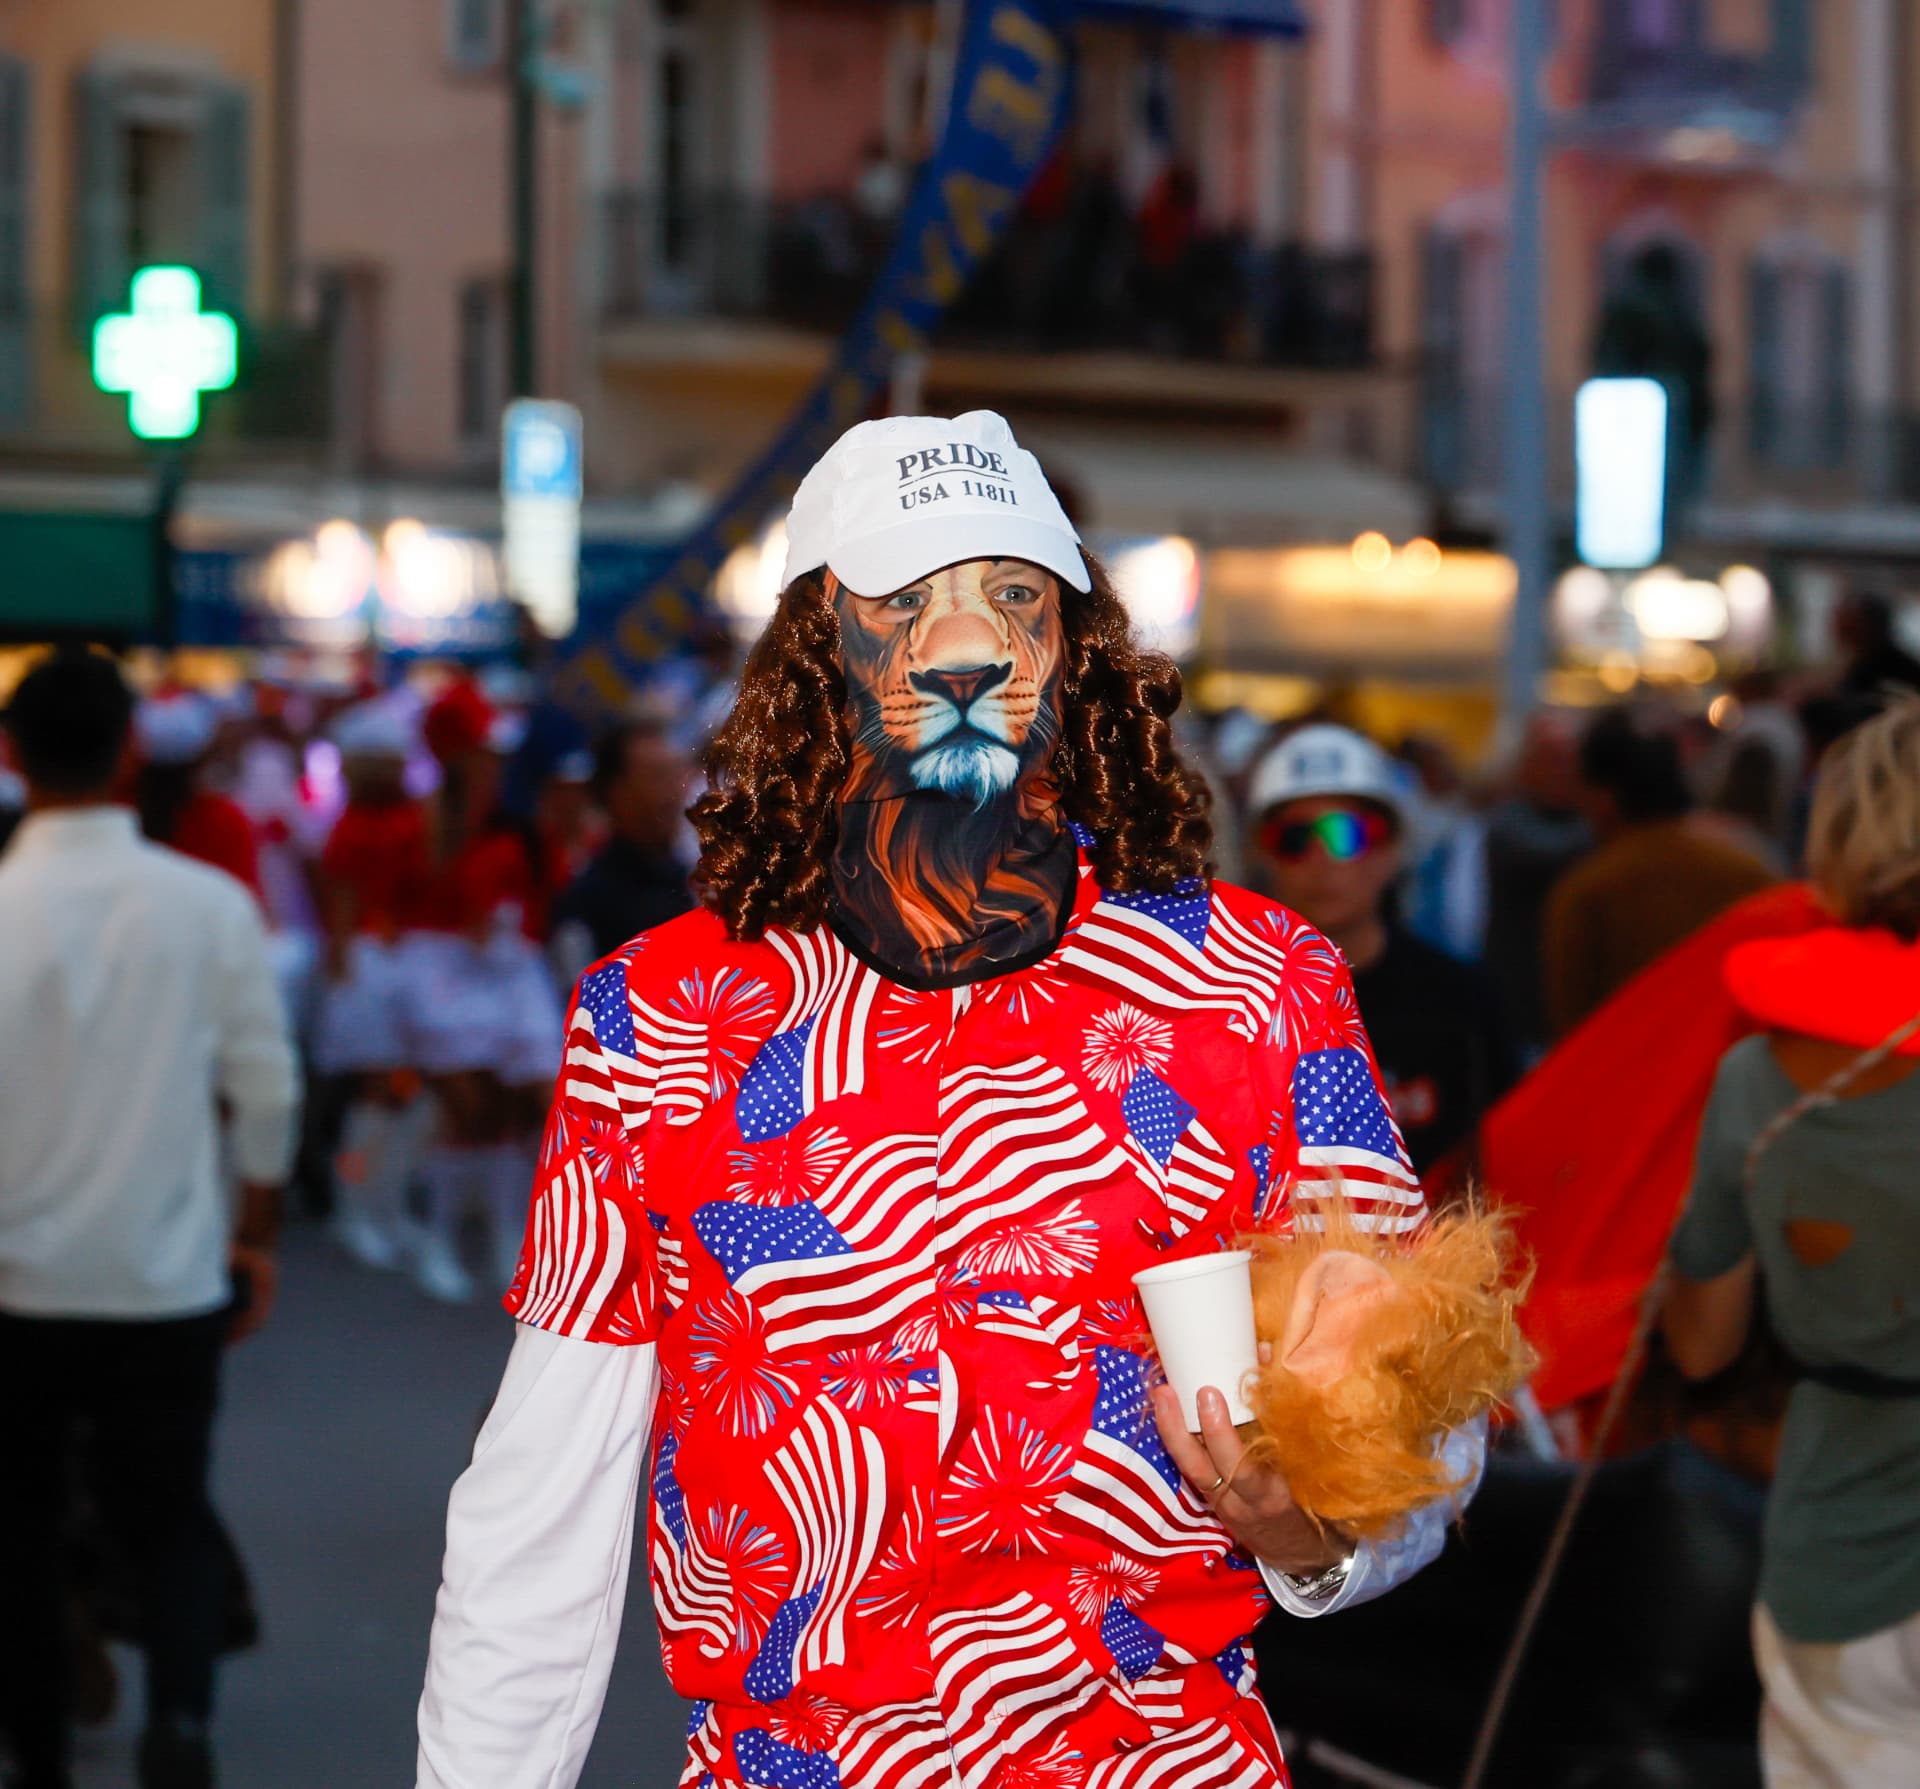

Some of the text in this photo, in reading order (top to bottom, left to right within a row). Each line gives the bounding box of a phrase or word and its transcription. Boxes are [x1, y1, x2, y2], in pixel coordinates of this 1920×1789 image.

[896, 443, 1008, 481] PRIDE
[900, 480, 1019, 510] USA 11811
